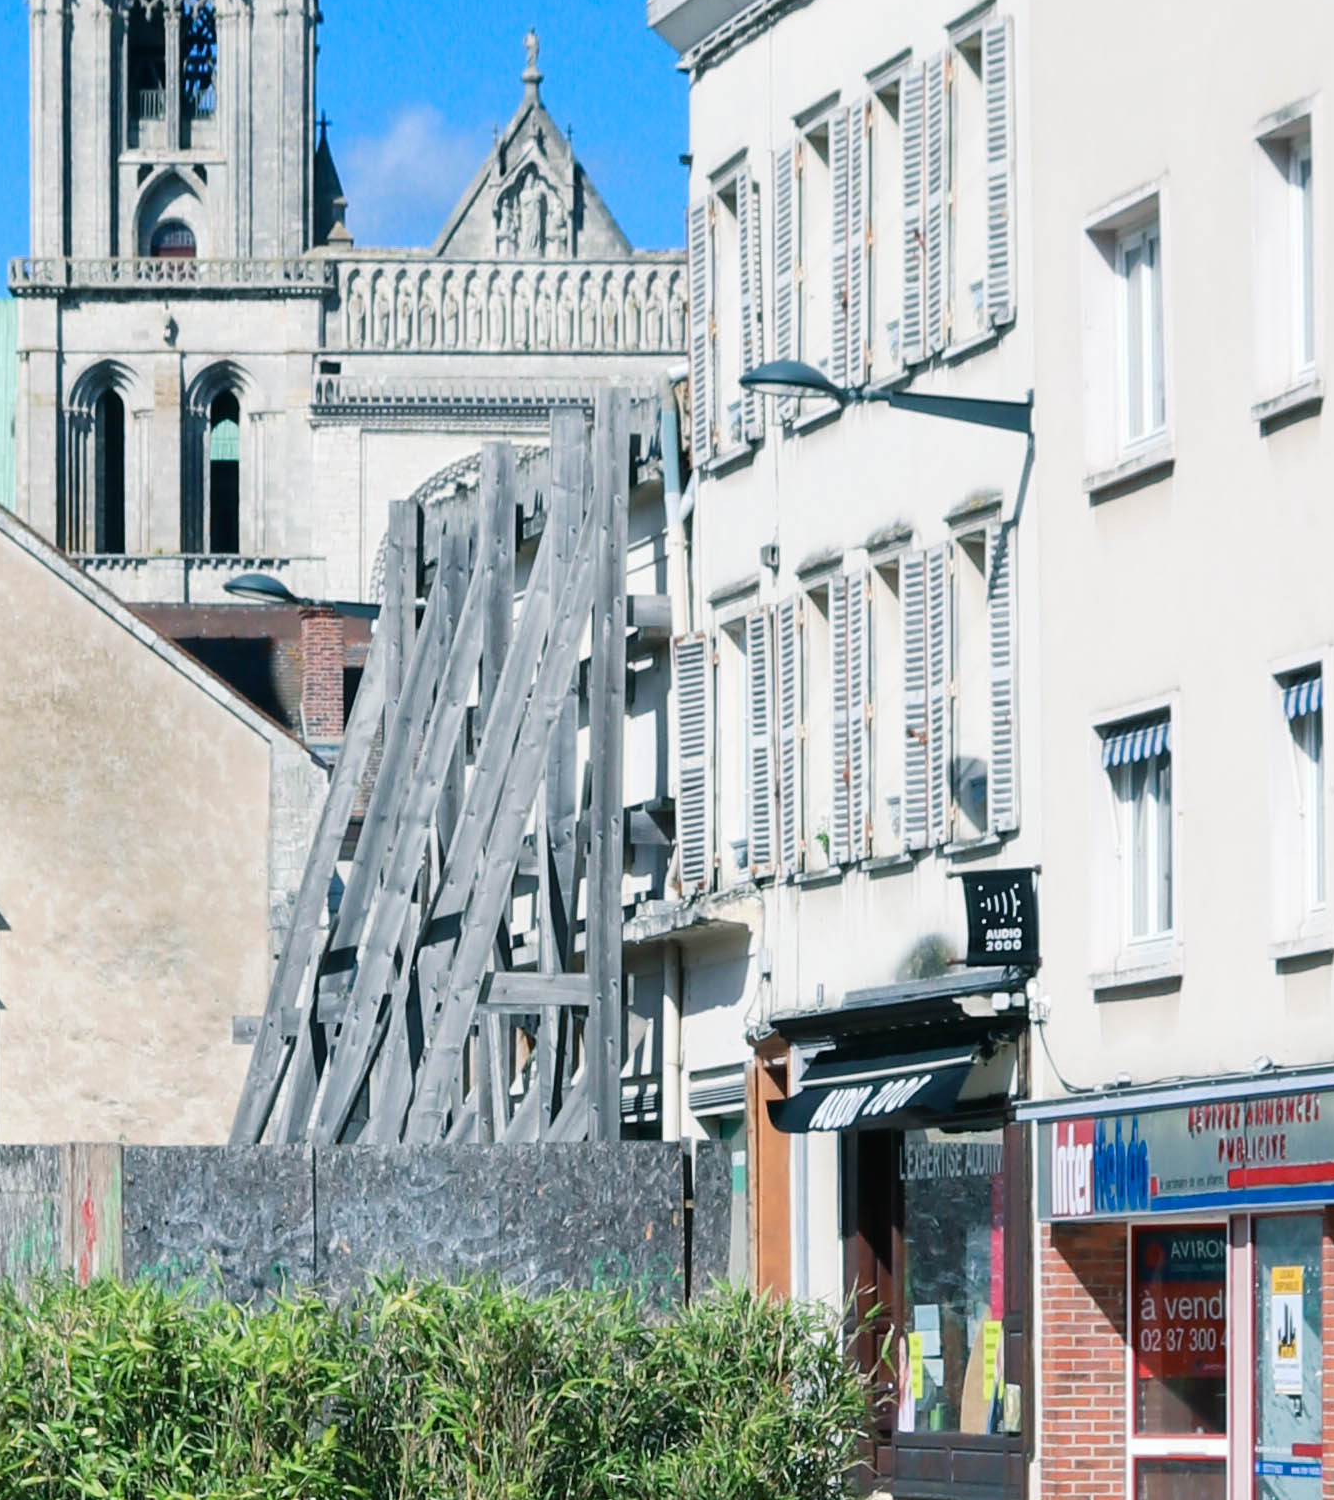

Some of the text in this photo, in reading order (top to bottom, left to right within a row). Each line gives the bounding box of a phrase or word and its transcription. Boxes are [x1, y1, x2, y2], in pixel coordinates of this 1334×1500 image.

[985, 928, 1022, 940] AUDIO
[985, 939, 1022, 951] 2000
[1140, 1289, 1156, 1320] à
[1140, 1327, 1162, 1352] 02
[1166, 1327, 1185, 1352] 37
[1189, 1327, 1217, 1352] 300
